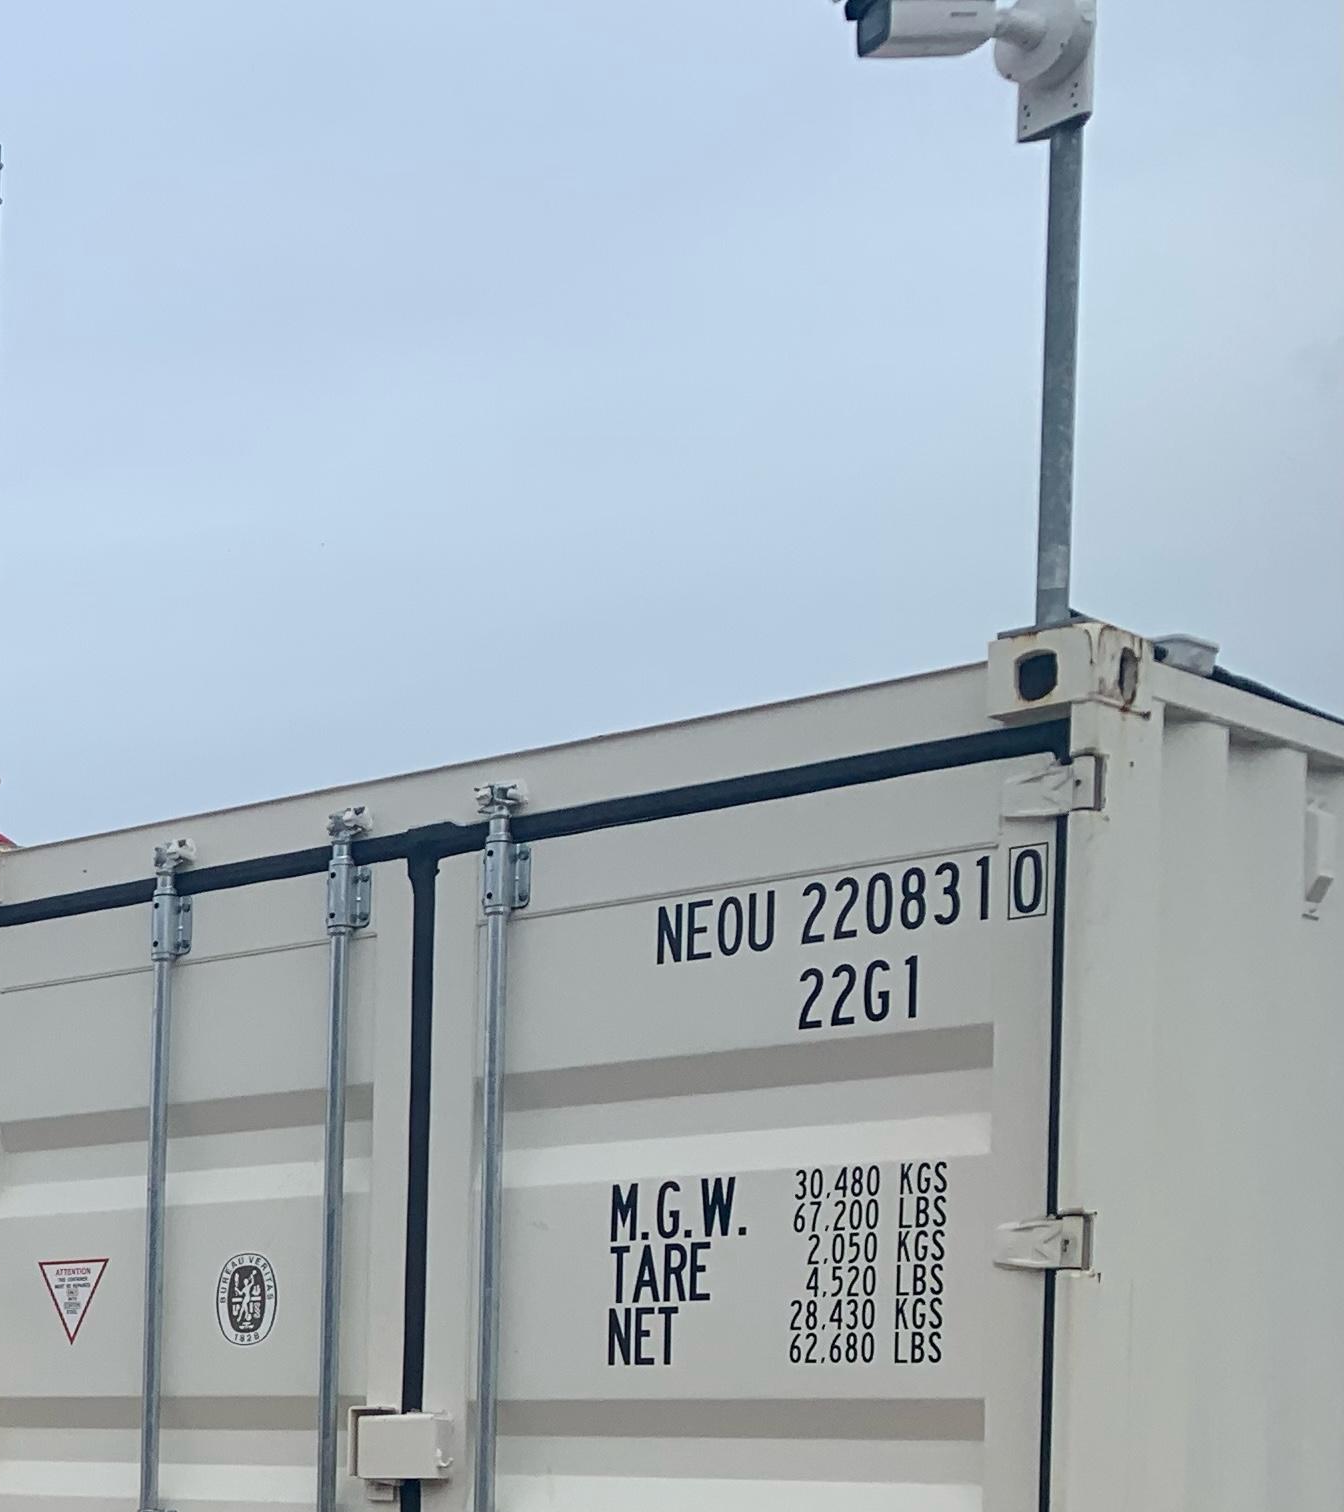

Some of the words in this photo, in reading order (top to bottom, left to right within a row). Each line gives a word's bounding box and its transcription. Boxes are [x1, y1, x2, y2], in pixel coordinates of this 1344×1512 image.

[656, 889, 776, 965] NEOU
[800, 855, 992, 946] 220831
[798, 954, 920, 1031] 22G1
[794, 1165, 880, 1200] 30,480
[899, 1161, 948, 1196] KGS
[610, 1176, 748, 1243] M.G.W.
[793, 1199, 879, 1233] 67,200
[898, 1195, 947, 1229] LBS
[807, 1232, 878, 1265] 2,050
[896, 1229, 946, 1263] KGS
[610, 1241, 712, 1304] TARE
[806, 1265, 877, 1298] 4,520
[896, 1264, 944, 1297] LBS
[790, 1299, 875, 1331] 28,430
[894, 1298, 943, 1330] KGS
[234, 1332, 260, 1342] 1828
[608, 1306, 679, 1366] NET
[789, 1332, 875, 1364] 62,680
[894, 1331, 943, 1364] LBS
